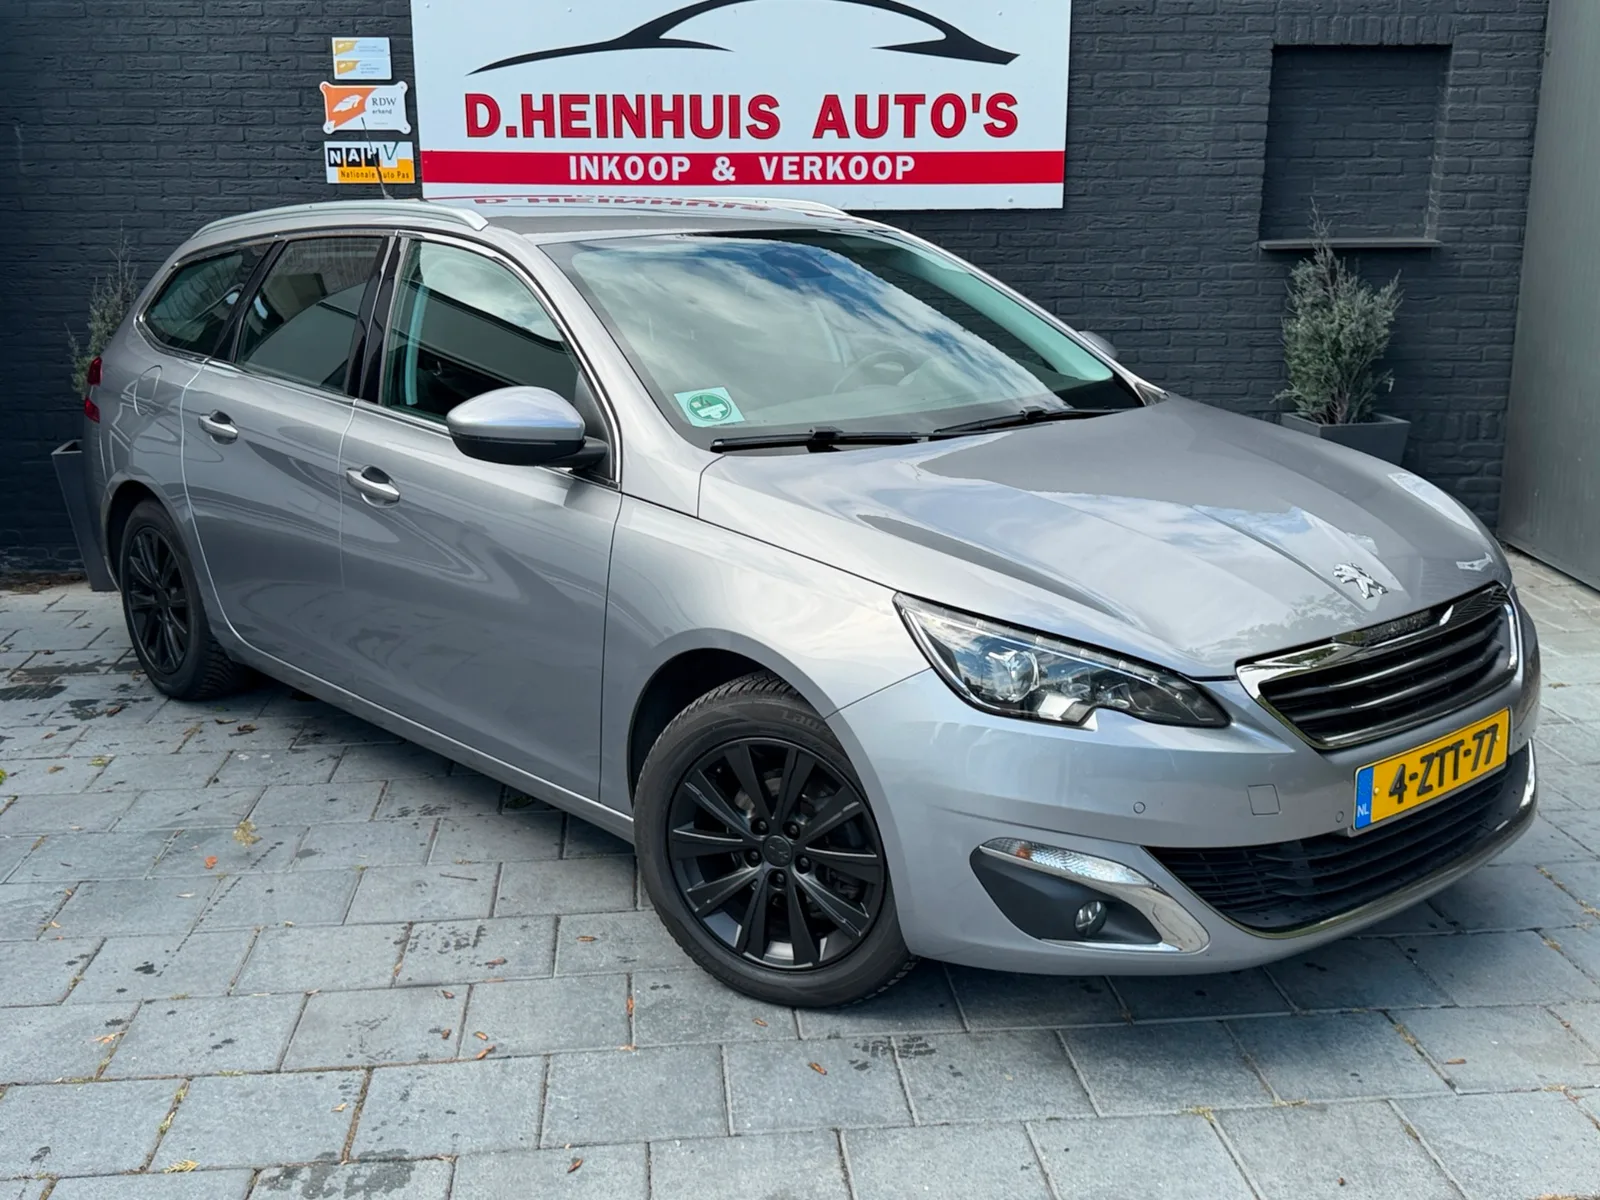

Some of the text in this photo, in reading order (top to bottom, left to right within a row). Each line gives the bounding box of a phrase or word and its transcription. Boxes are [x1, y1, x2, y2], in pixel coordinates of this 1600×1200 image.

[372, 97, 397, 106] RDW
[465, 93, 1018, 139] D.HEINHUIS AUTO'S
[569, 155, 915, 181] INKOOP & VERKOOP
[1389, 723, 1499, 804] 4-ZTT-77
[1357, 803, 1369, 817] NL
